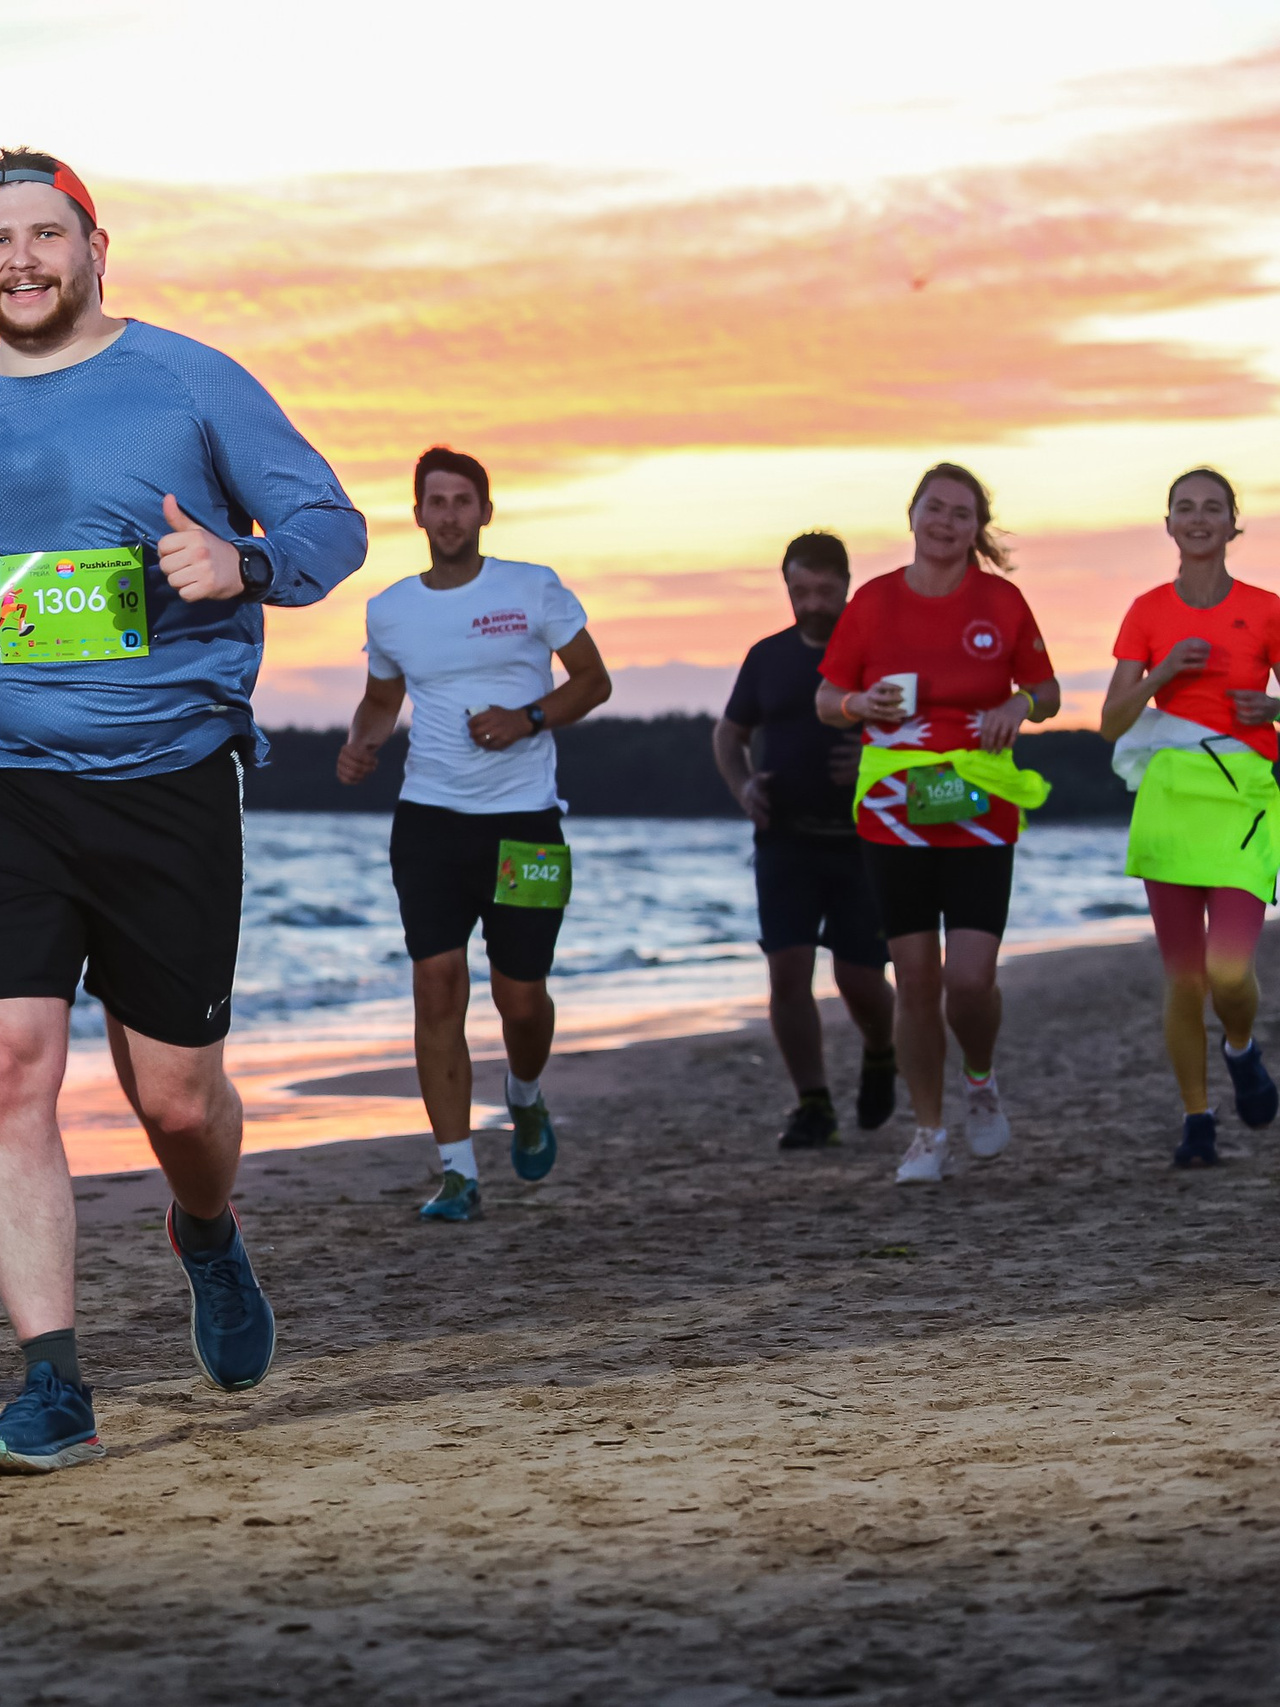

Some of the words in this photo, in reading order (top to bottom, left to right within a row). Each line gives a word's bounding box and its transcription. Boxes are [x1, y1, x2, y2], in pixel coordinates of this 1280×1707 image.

[80, 560, 132, 569] PushkinRun
[33, 586, 106, 614] 1306
[118, 591, 139, 609] 10
[481, 623, 528, 635] РОССИИ
[125, 632, 139, 648] D
[522, 864, 561, 882] 1242
